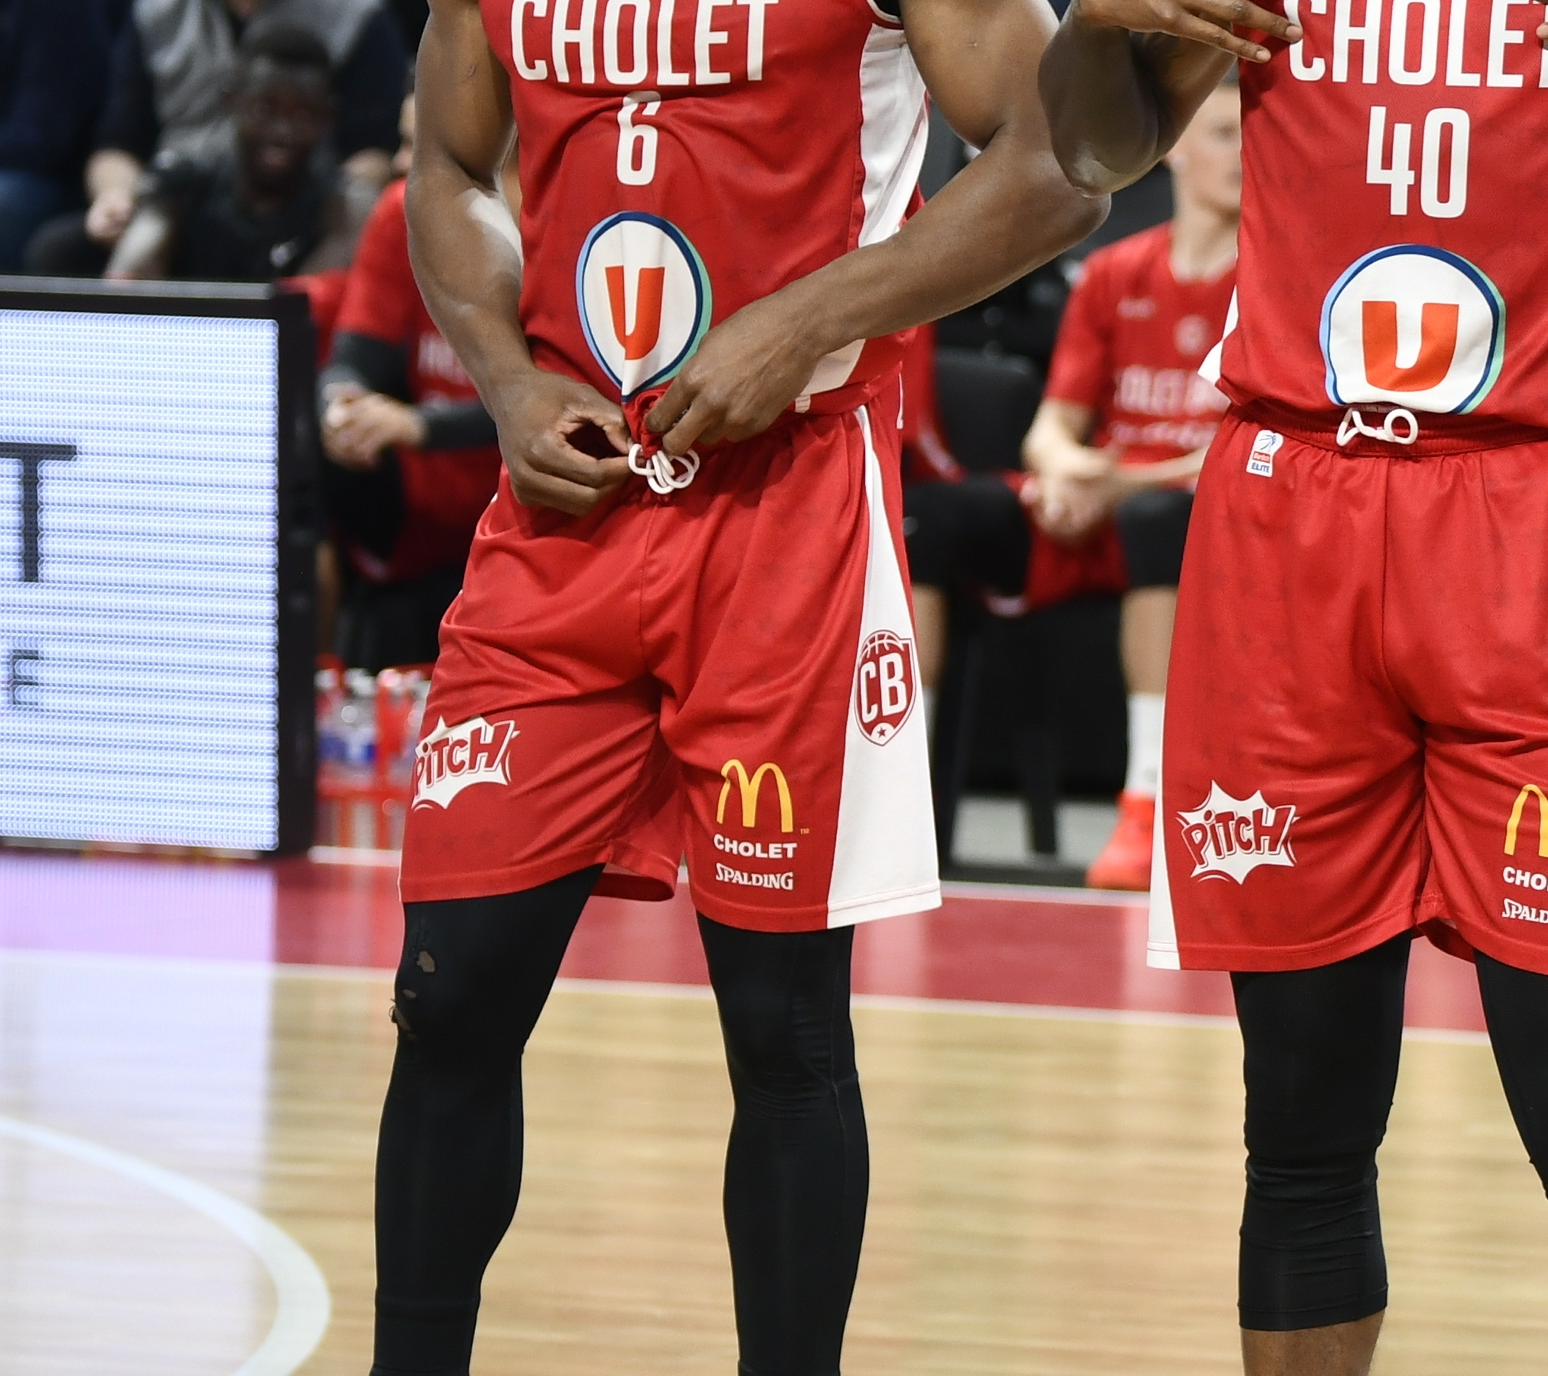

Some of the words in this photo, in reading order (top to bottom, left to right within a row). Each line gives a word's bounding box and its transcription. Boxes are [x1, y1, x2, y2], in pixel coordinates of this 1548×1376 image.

[616, 91, 661, 186] 6
[1365, 106, 1470, 218] 40
[859, 652, 905, 722] CB
[713, 833, 797, 859] CHOLET
[715, 862, 793, 891] SPALDING
